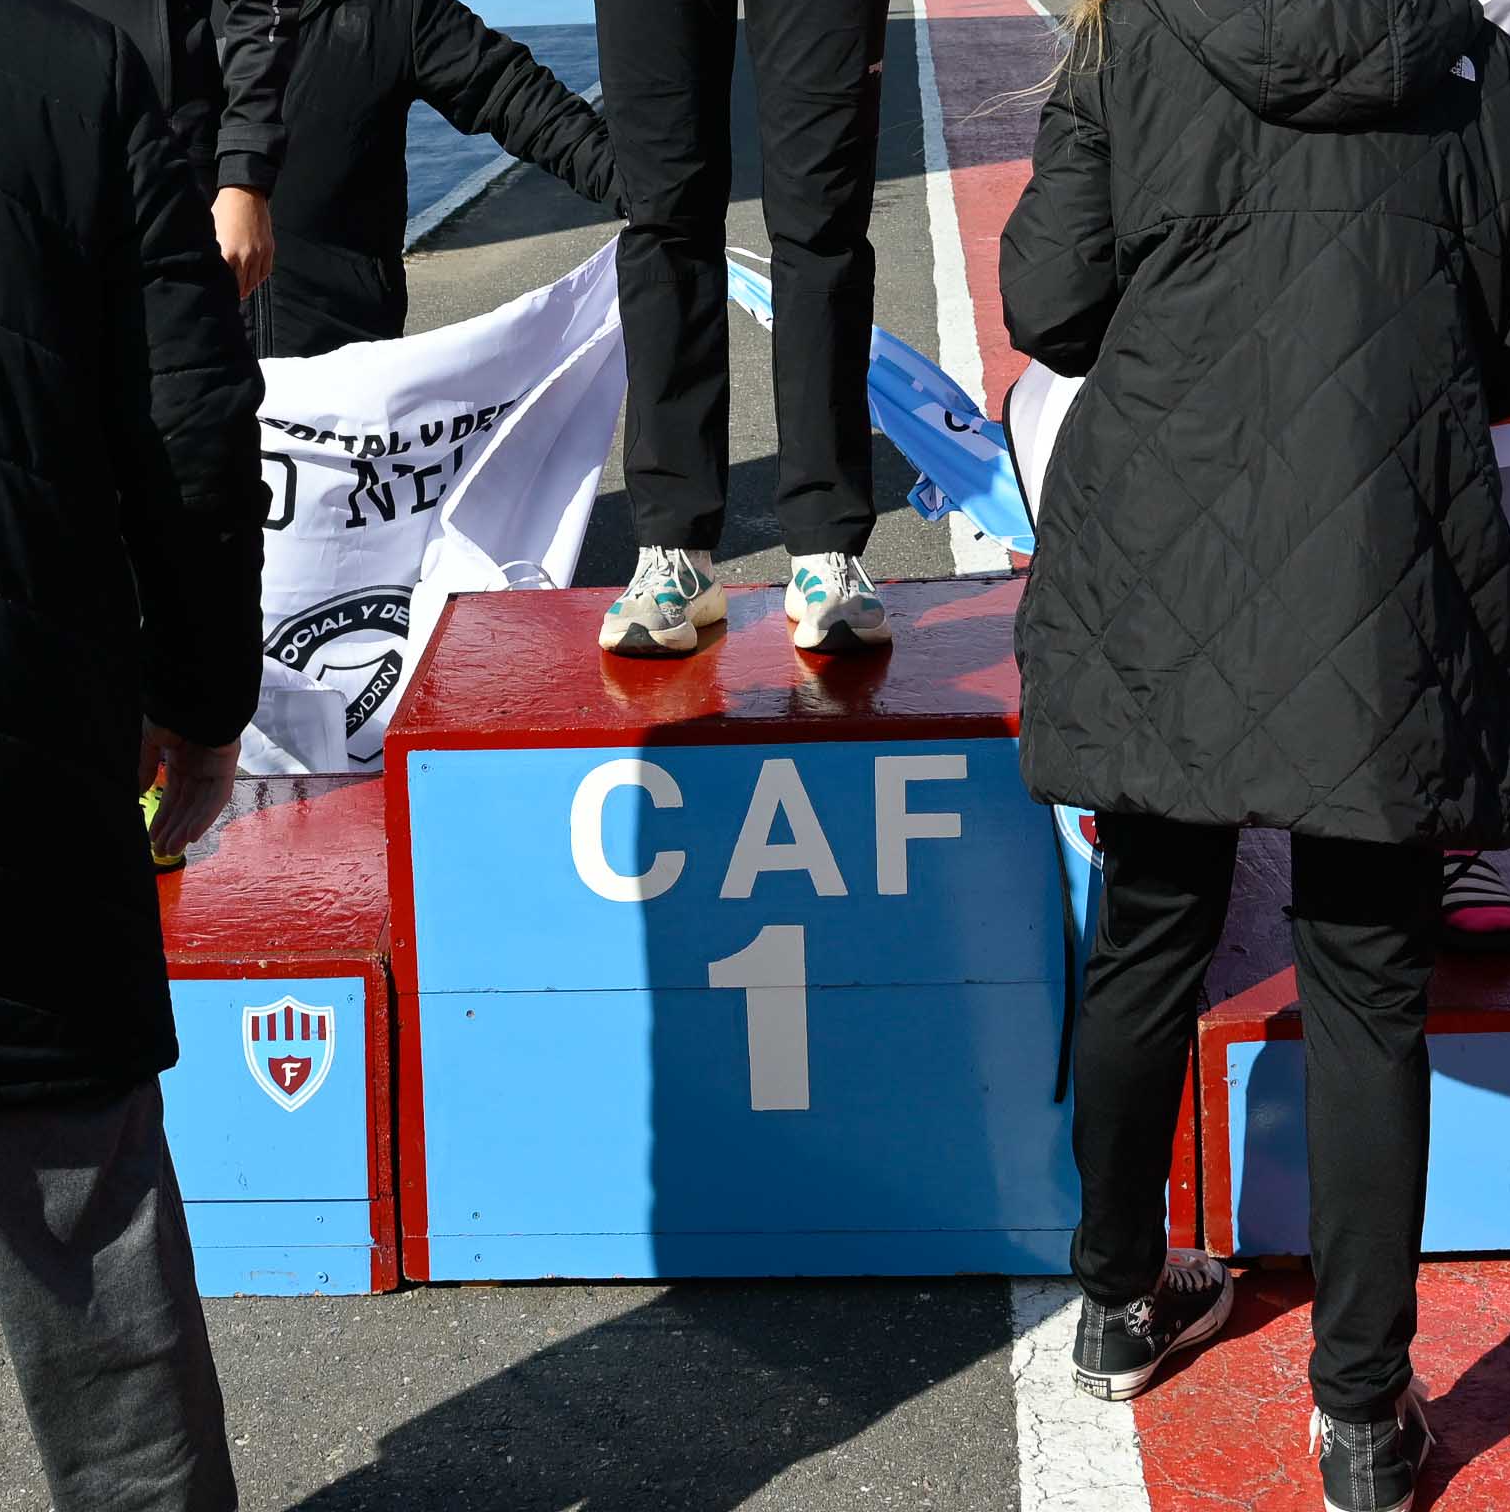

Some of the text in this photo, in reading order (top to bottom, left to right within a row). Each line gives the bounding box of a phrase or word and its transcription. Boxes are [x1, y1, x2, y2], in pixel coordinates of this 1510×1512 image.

[279, 603, 410, 664] OCIAL Y DE
[569, 752, 968, 903] CAF
[707, 924, 810, 1111] 1
[279, 1061, 303, 1089] F
